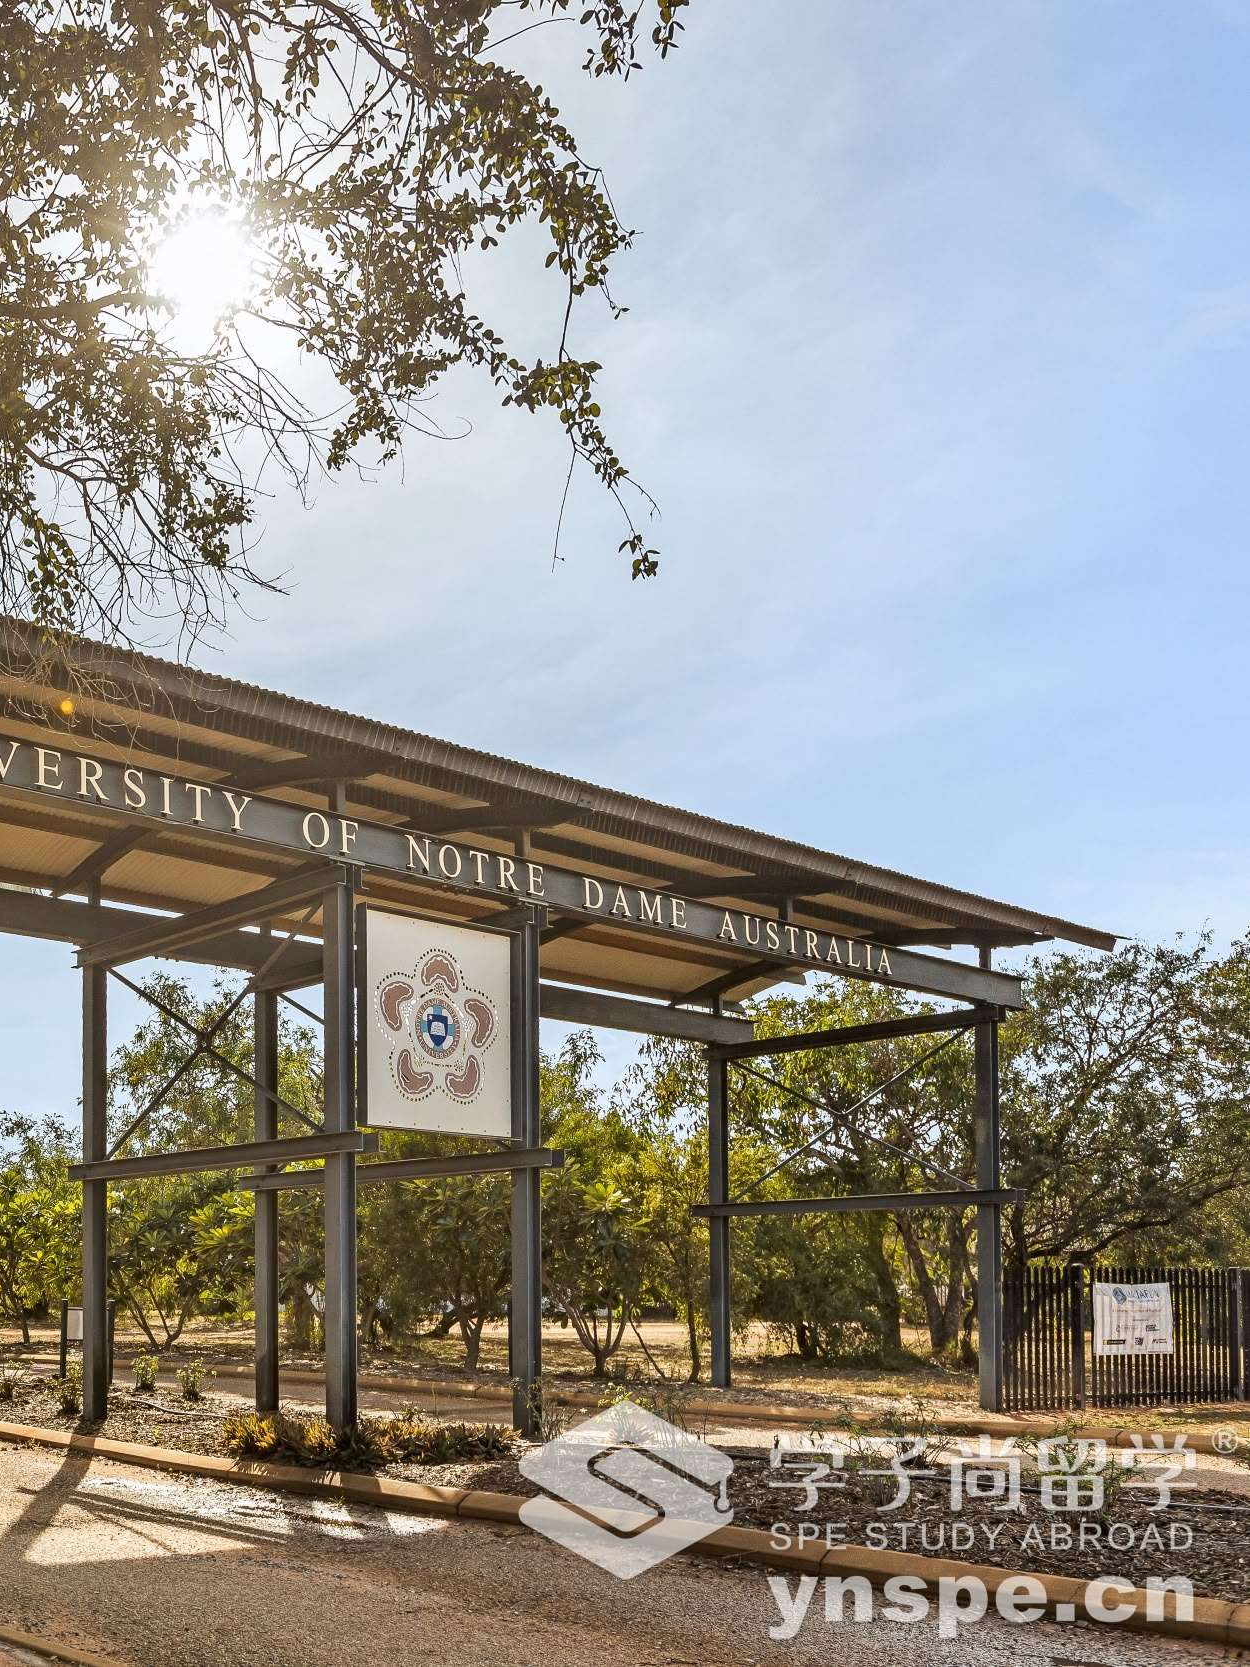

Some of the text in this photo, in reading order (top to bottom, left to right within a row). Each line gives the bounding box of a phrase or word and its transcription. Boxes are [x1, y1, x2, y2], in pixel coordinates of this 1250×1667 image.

[302, 812, 359, 854] OF
[407, 835, 545, 897] NOTRE
[583, 877, 688, 929] DAME
[716, 911, 892, 976] AUSTRALIA
